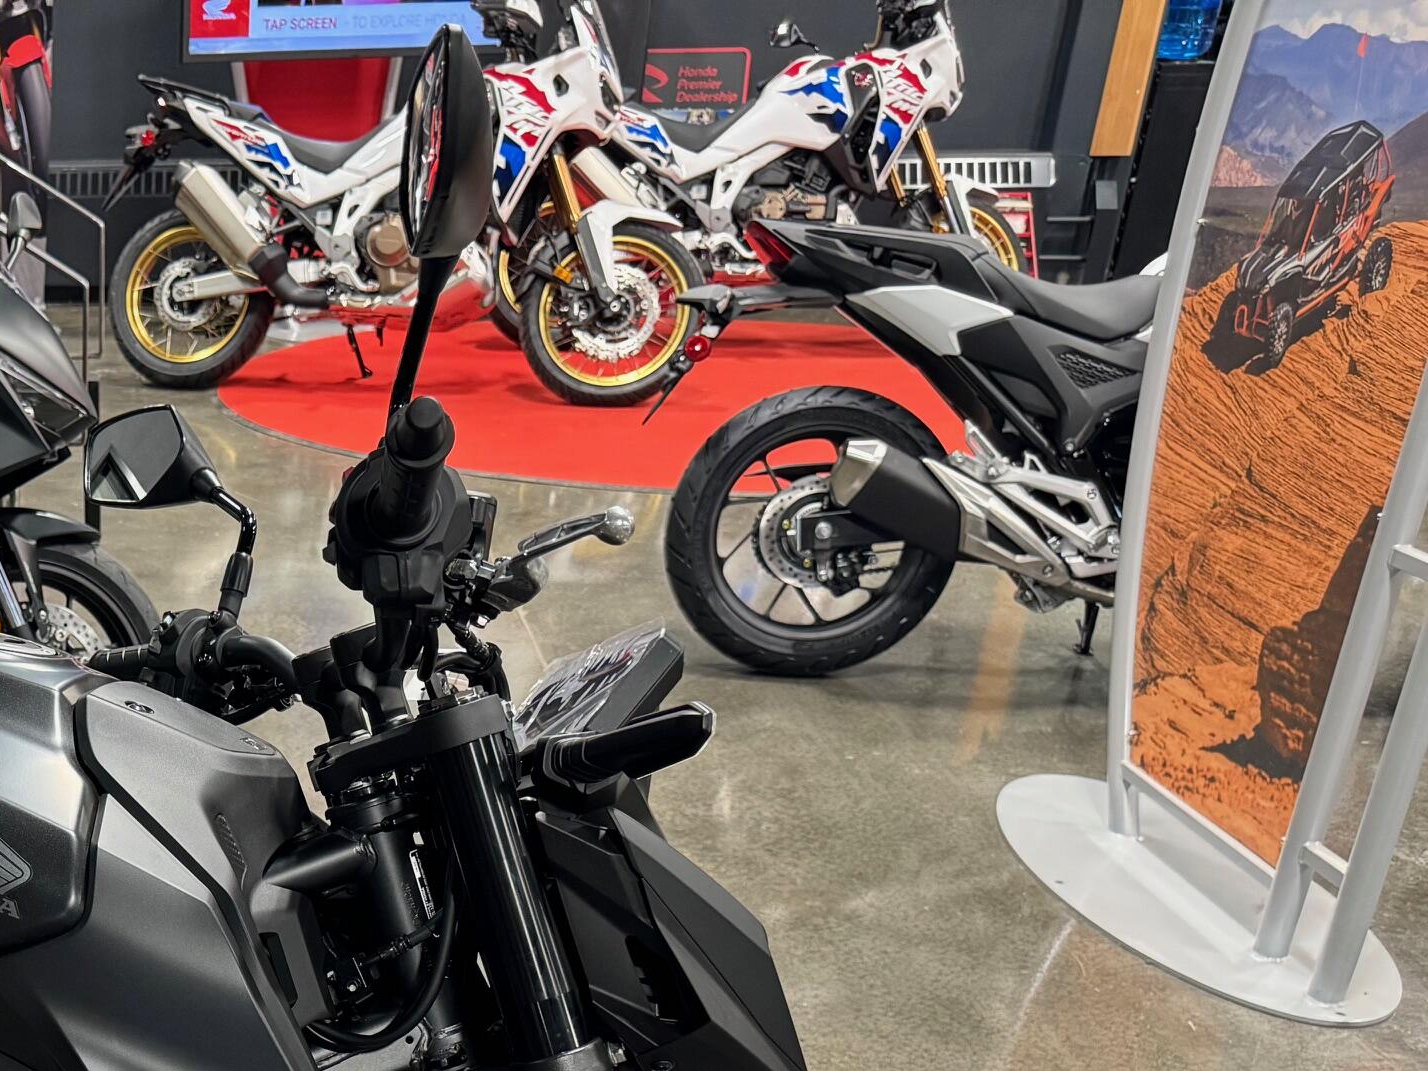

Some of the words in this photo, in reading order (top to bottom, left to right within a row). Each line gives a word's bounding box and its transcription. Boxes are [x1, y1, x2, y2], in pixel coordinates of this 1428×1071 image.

[264, 18, 288, 30] TAP
[290, 17, 338, 30] SCREEN
[678, 66, 718, 77] Honda
[677, 79, 723, 90] Premier
[676, 91, 738, 103] Dealership
